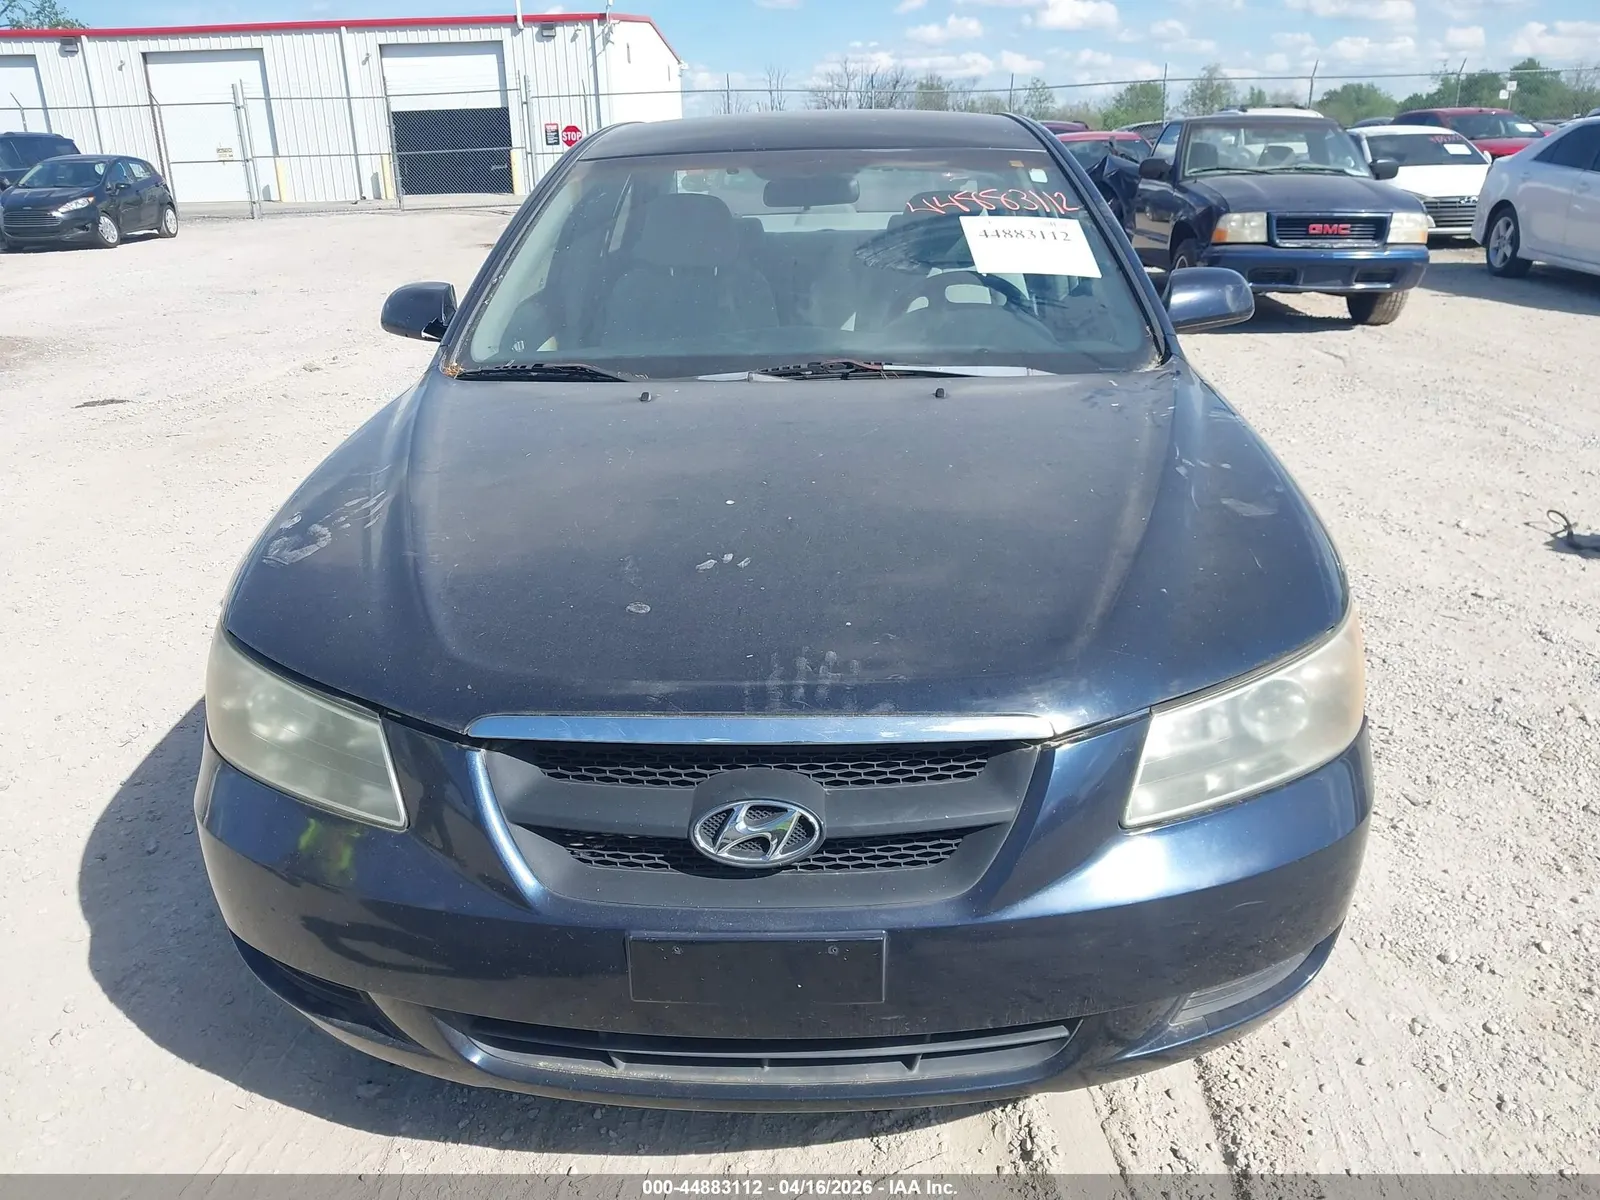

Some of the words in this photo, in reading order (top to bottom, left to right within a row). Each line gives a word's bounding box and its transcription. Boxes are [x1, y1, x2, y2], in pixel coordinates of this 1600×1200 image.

[562, 131, 582, 141] STOP
[979, 229, 1071, 241] 44883112
[1308, 224, 1351, 235] GMC
